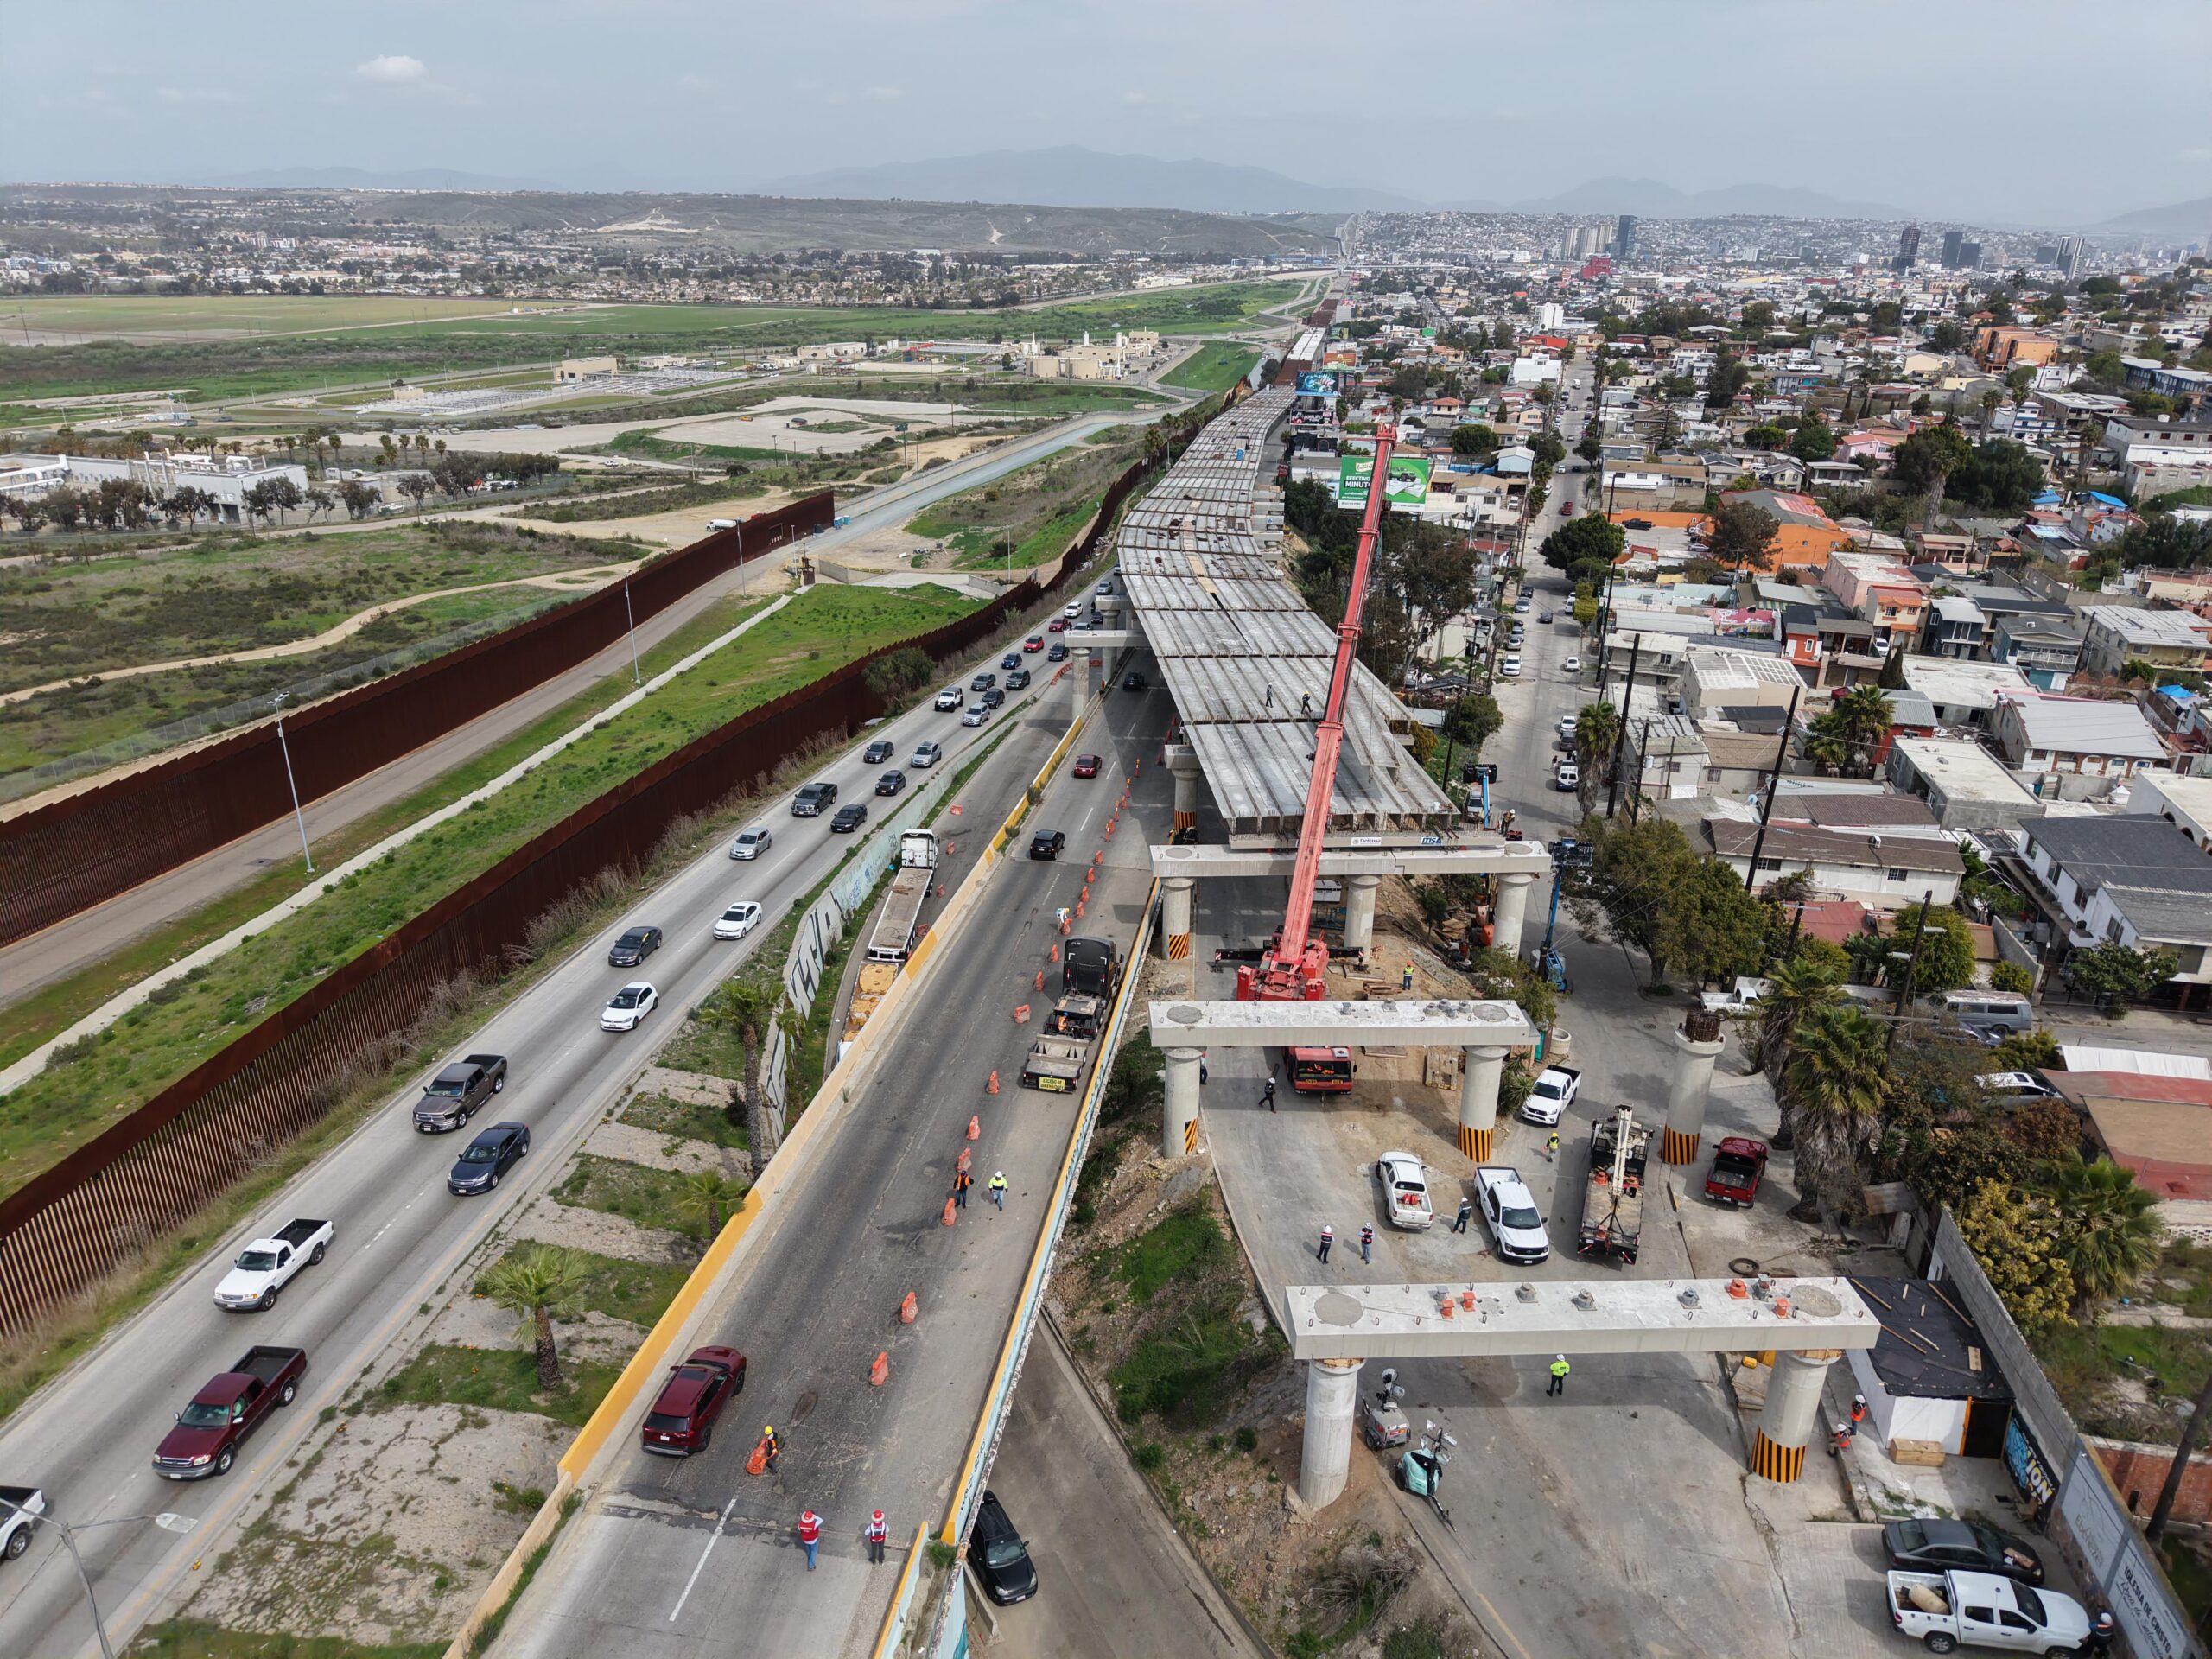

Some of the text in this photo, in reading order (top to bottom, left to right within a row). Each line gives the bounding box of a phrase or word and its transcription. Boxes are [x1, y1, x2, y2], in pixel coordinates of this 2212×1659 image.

[2124, 1565, 2145, 1605] IGLESIA
[2143, 1602, 2154, 1619] DE
[2151, 1616, 2171, 1654] CRISTO
